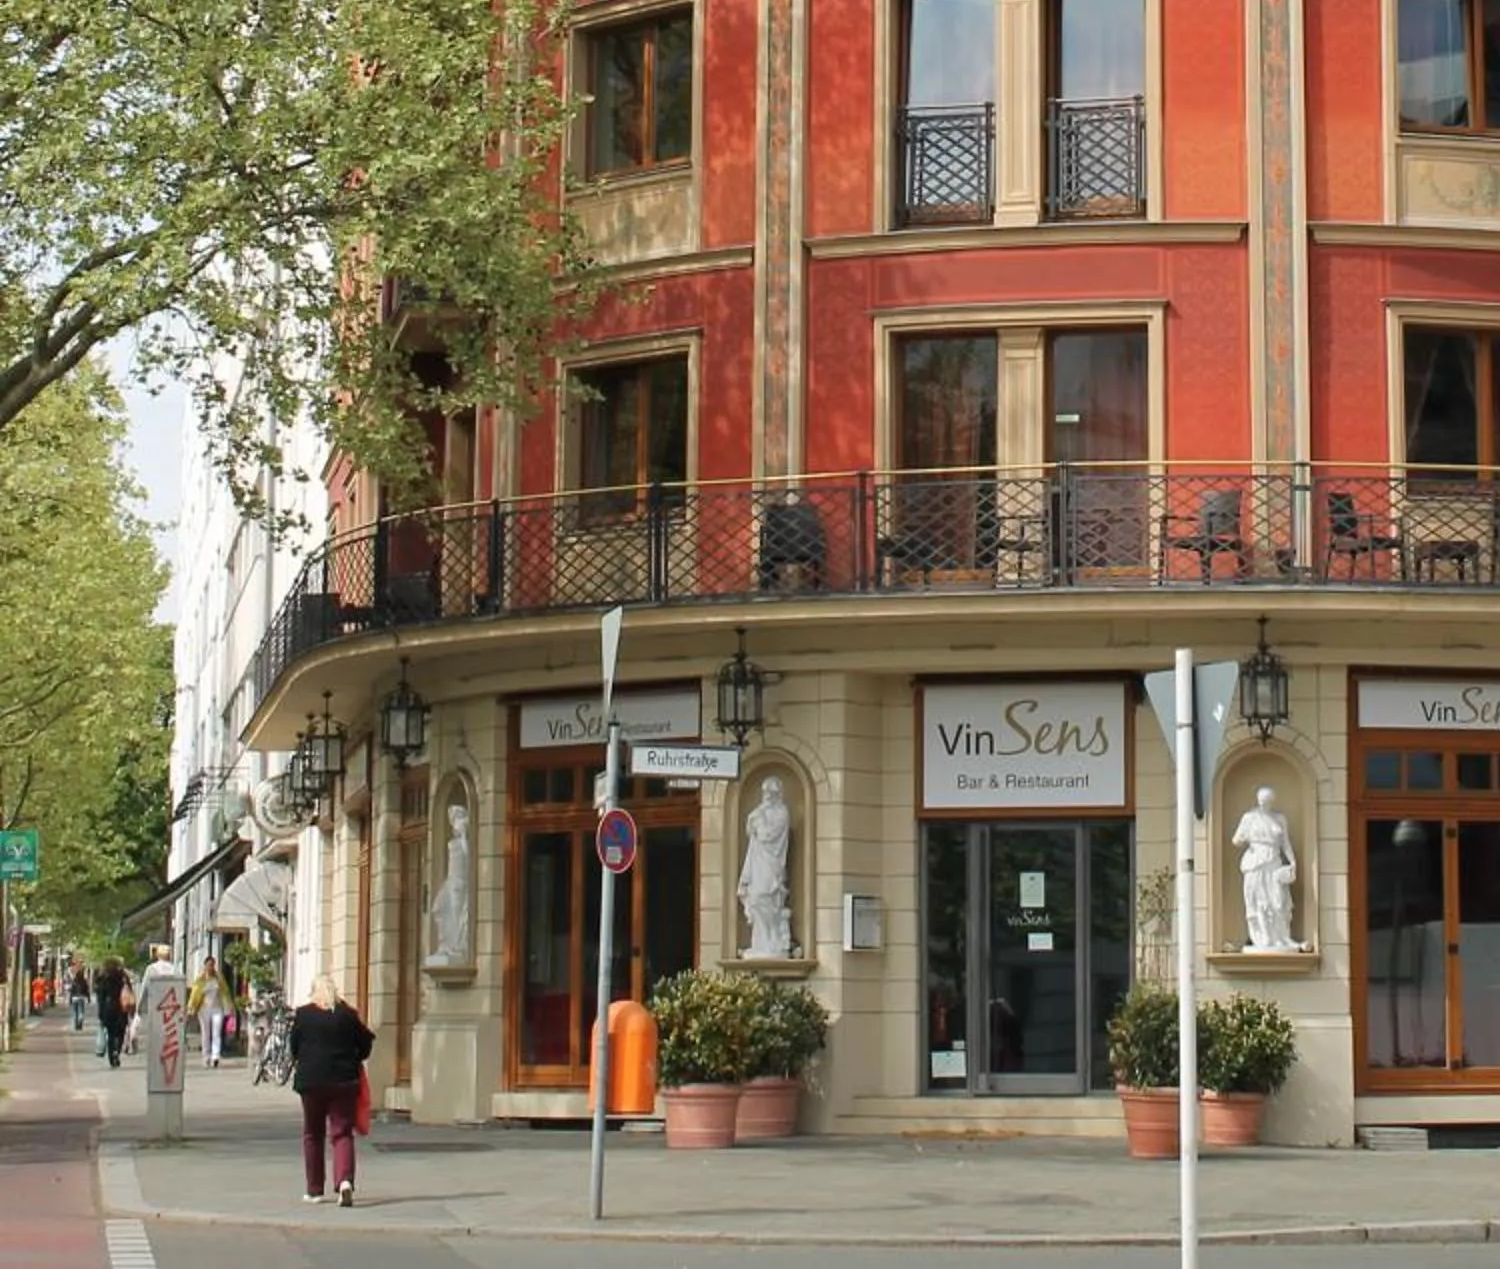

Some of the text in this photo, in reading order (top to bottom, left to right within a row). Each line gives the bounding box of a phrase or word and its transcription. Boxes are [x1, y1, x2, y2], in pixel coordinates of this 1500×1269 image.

[938, 700, 1109, 756] VinSens
[957, 773, 1089, 789] Bar & Restaurant
